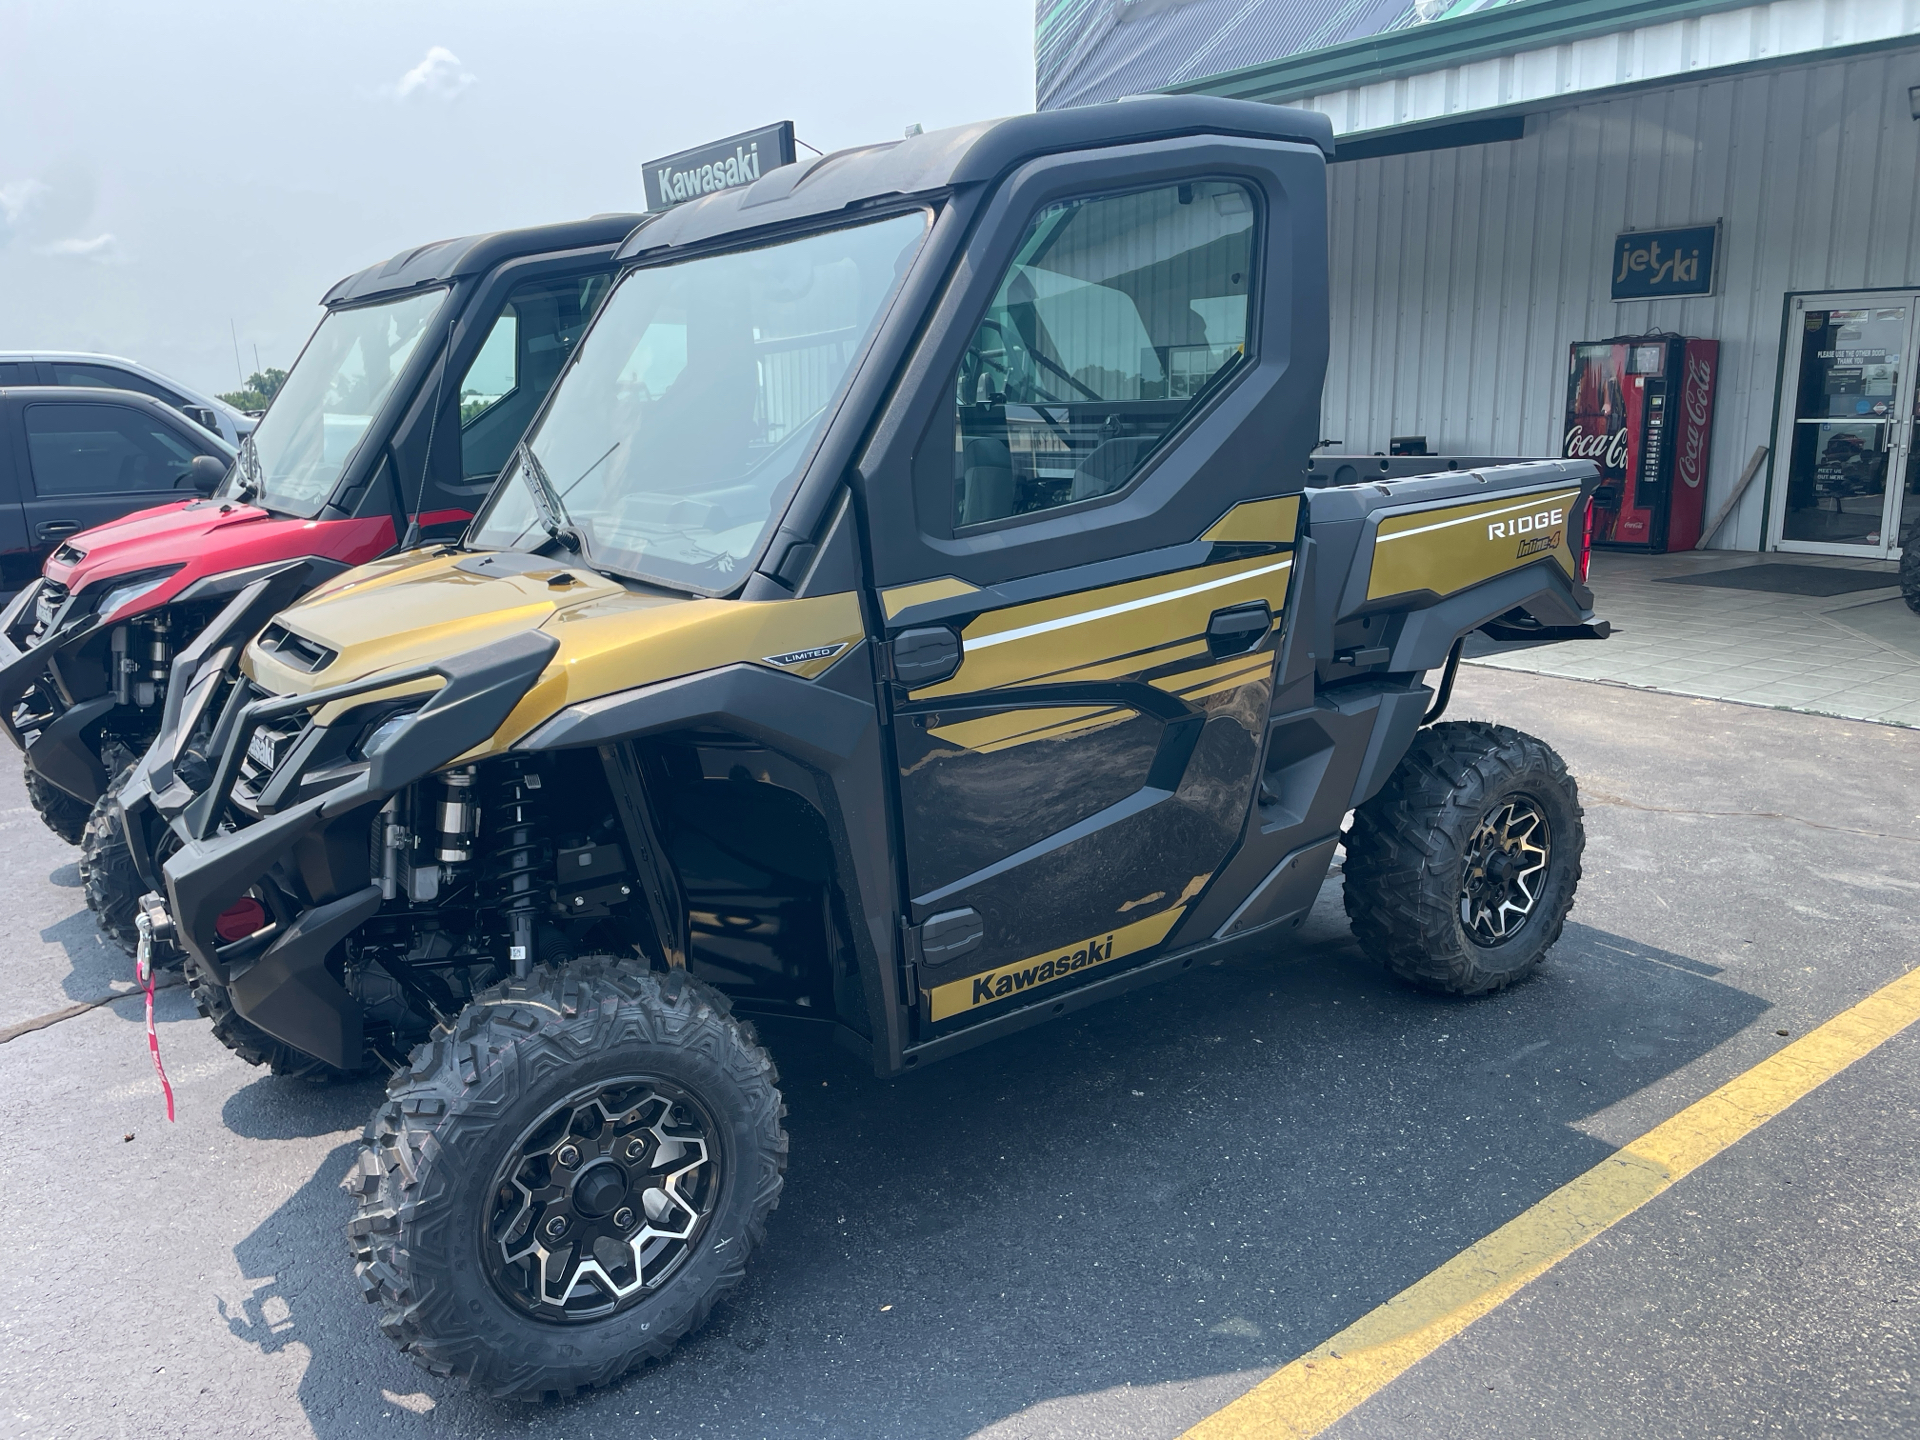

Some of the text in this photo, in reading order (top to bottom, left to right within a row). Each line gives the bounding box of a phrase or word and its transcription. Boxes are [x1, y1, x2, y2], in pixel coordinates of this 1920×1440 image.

[657, 142, 760, 204] Kawasaki
[1817, 349, 1886, 359] PLEASE USE THE OTHER DOOR
[1837, 357, 1864, 365] THANK YOU
[1680, 350, 1711, 488] Coca-Cola
[1488, 508, 1563, 541] RIDGE
[785, 648, 831, 663] LIMITED
[972, 934, 1114, 1006] Kawasaki
